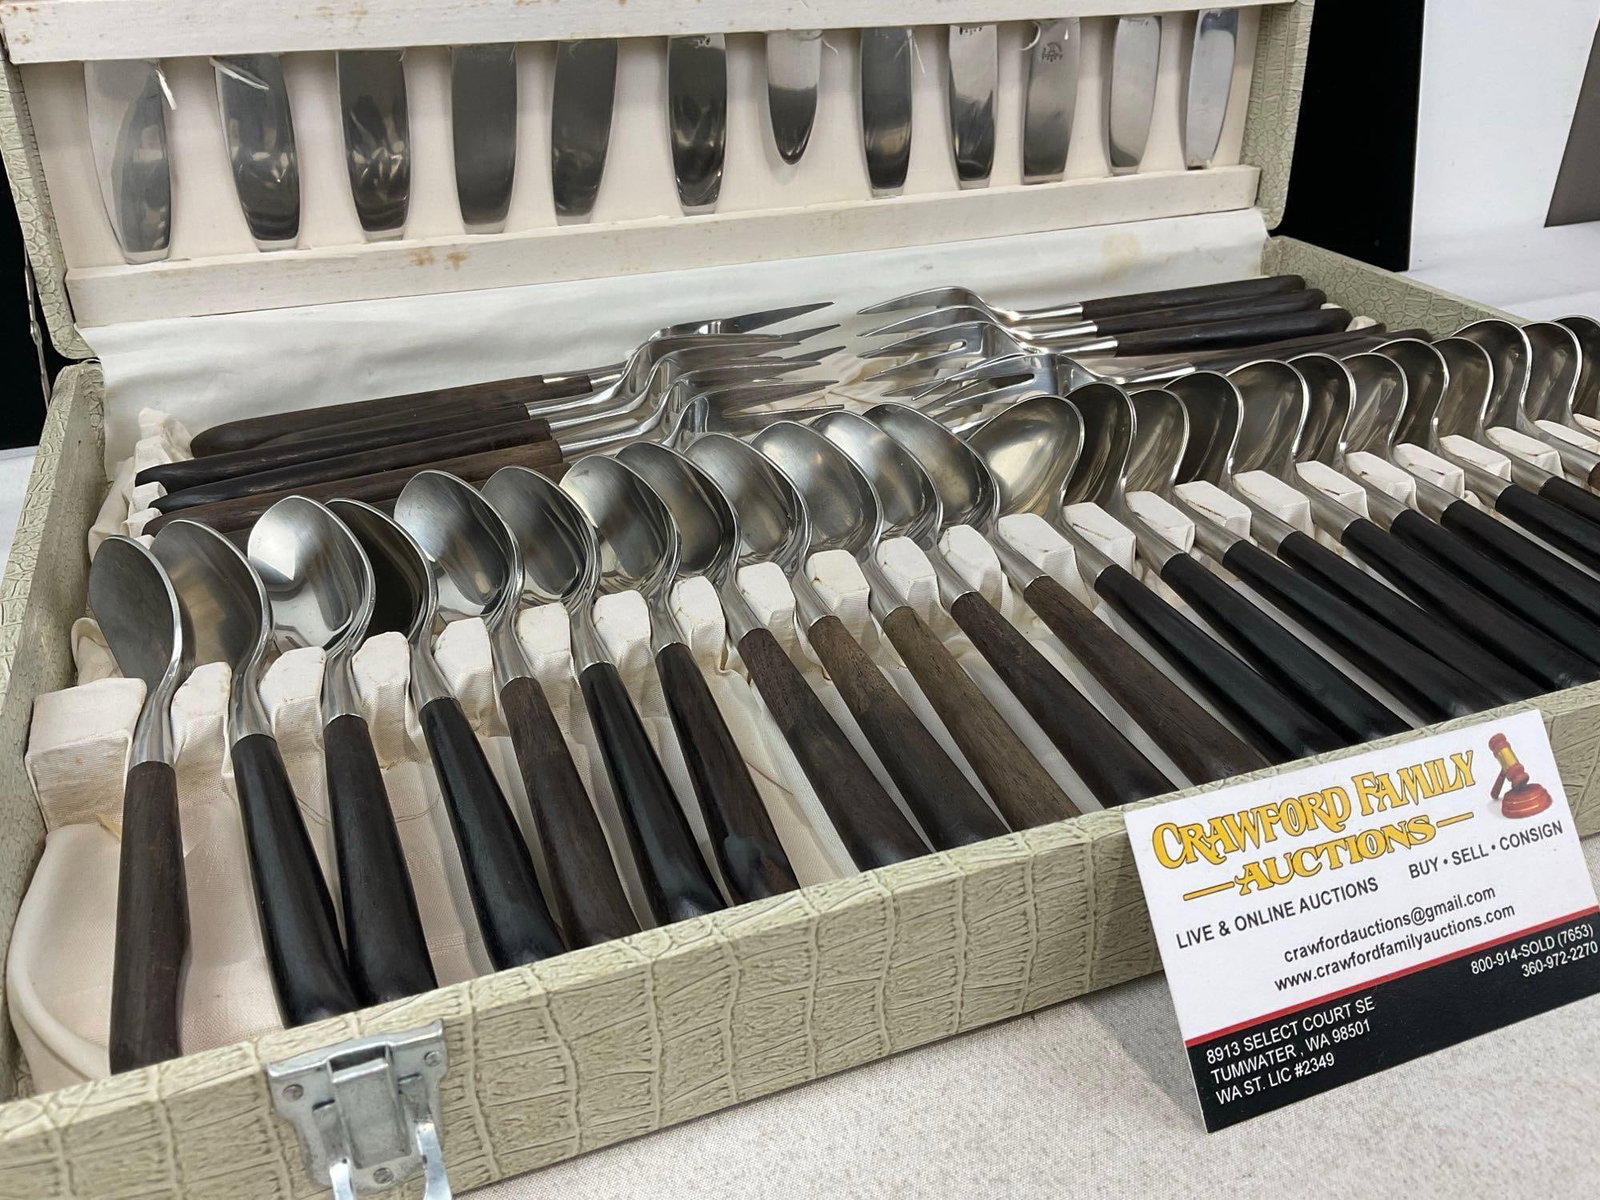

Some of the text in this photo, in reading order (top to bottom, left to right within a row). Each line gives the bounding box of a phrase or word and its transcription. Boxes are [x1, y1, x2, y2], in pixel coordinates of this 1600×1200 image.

[1152, 750, 1476, 869] CRAWFORD FAMILY
[1234, 814, 1436, 896] AUCTIONS
[1408, 820, 1564, 879] BUY SELL CONSIGN
[1175, 876, 1379, 949] LIVE & ONLINE AUCTIONS
[1283, 886, 1496, 963] crawfordauctions@gmail.com
[1274, 904, 1516, 991] www.crawfordfamilyauctions.com
[1470, 923, 1594, 975] 800-914-SOLD (7653)
[1521, 940, 1598, 978] 360-972-2270
[1206, 995, 1376, 1064] 8913 SELECT COURT SE
[1211, 1044, 1297, 1084] TUMWATER
[1305, 1033, 1331, 1052] WA
[1333, 1018, 1372, 1043] 98501
[1215, 1052, 1336, 1105] WA ST. LIC #2349
